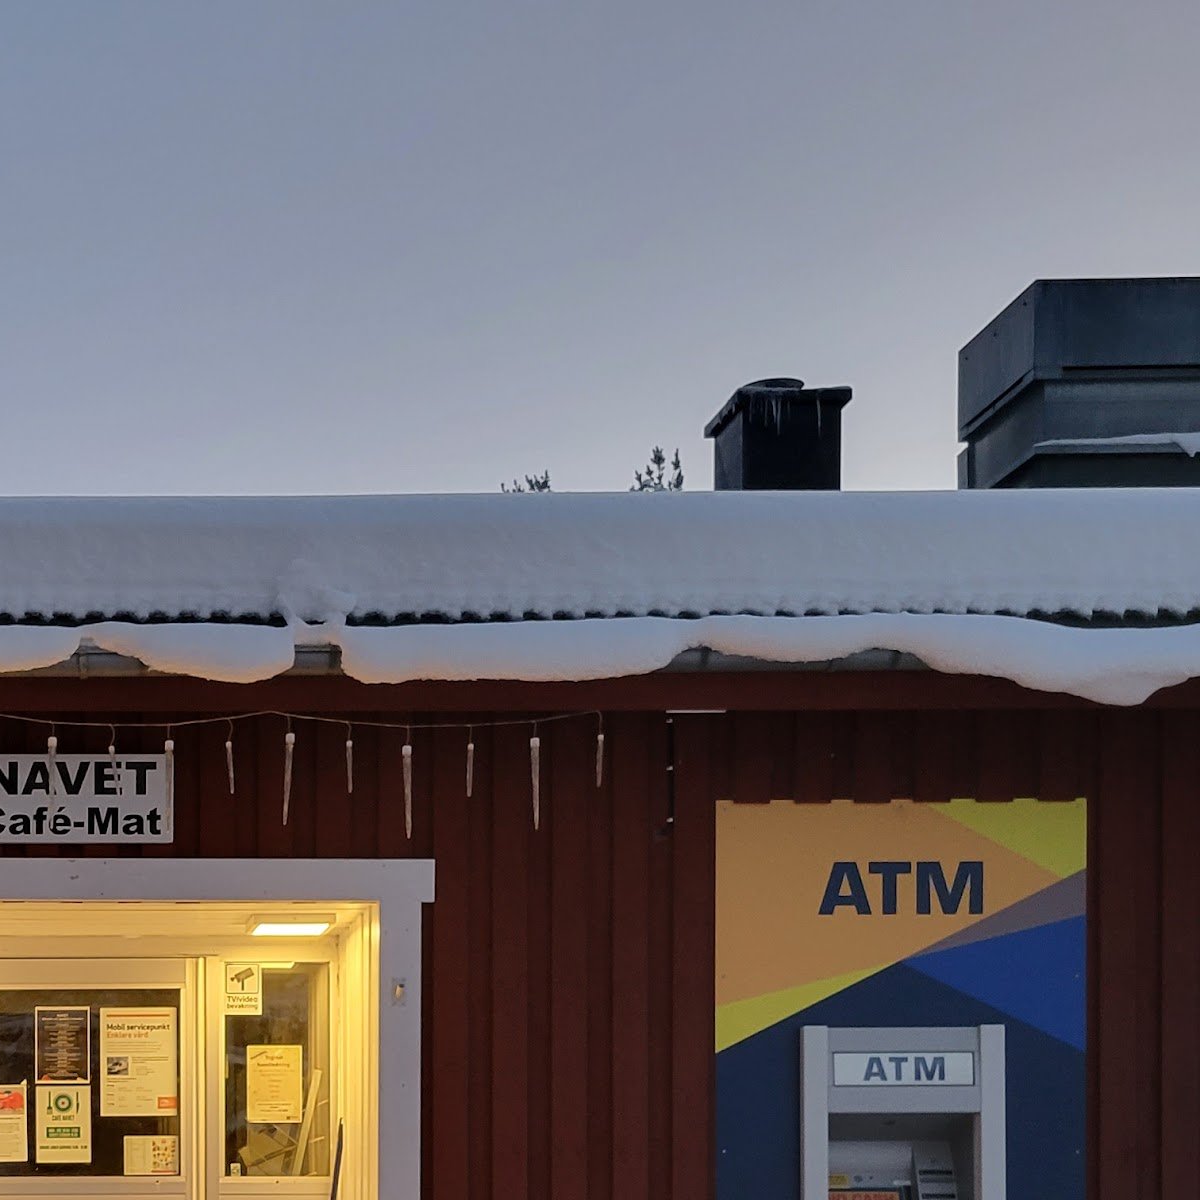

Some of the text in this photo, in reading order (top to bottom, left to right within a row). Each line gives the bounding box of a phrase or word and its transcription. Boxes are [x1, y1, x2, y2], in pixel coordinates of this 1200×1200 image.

[818, 861, 984, 915] ATM
[106, 1023, 170, 1032] Mobil servicepunkt
[863, 1056, 946, 1081] ATM
